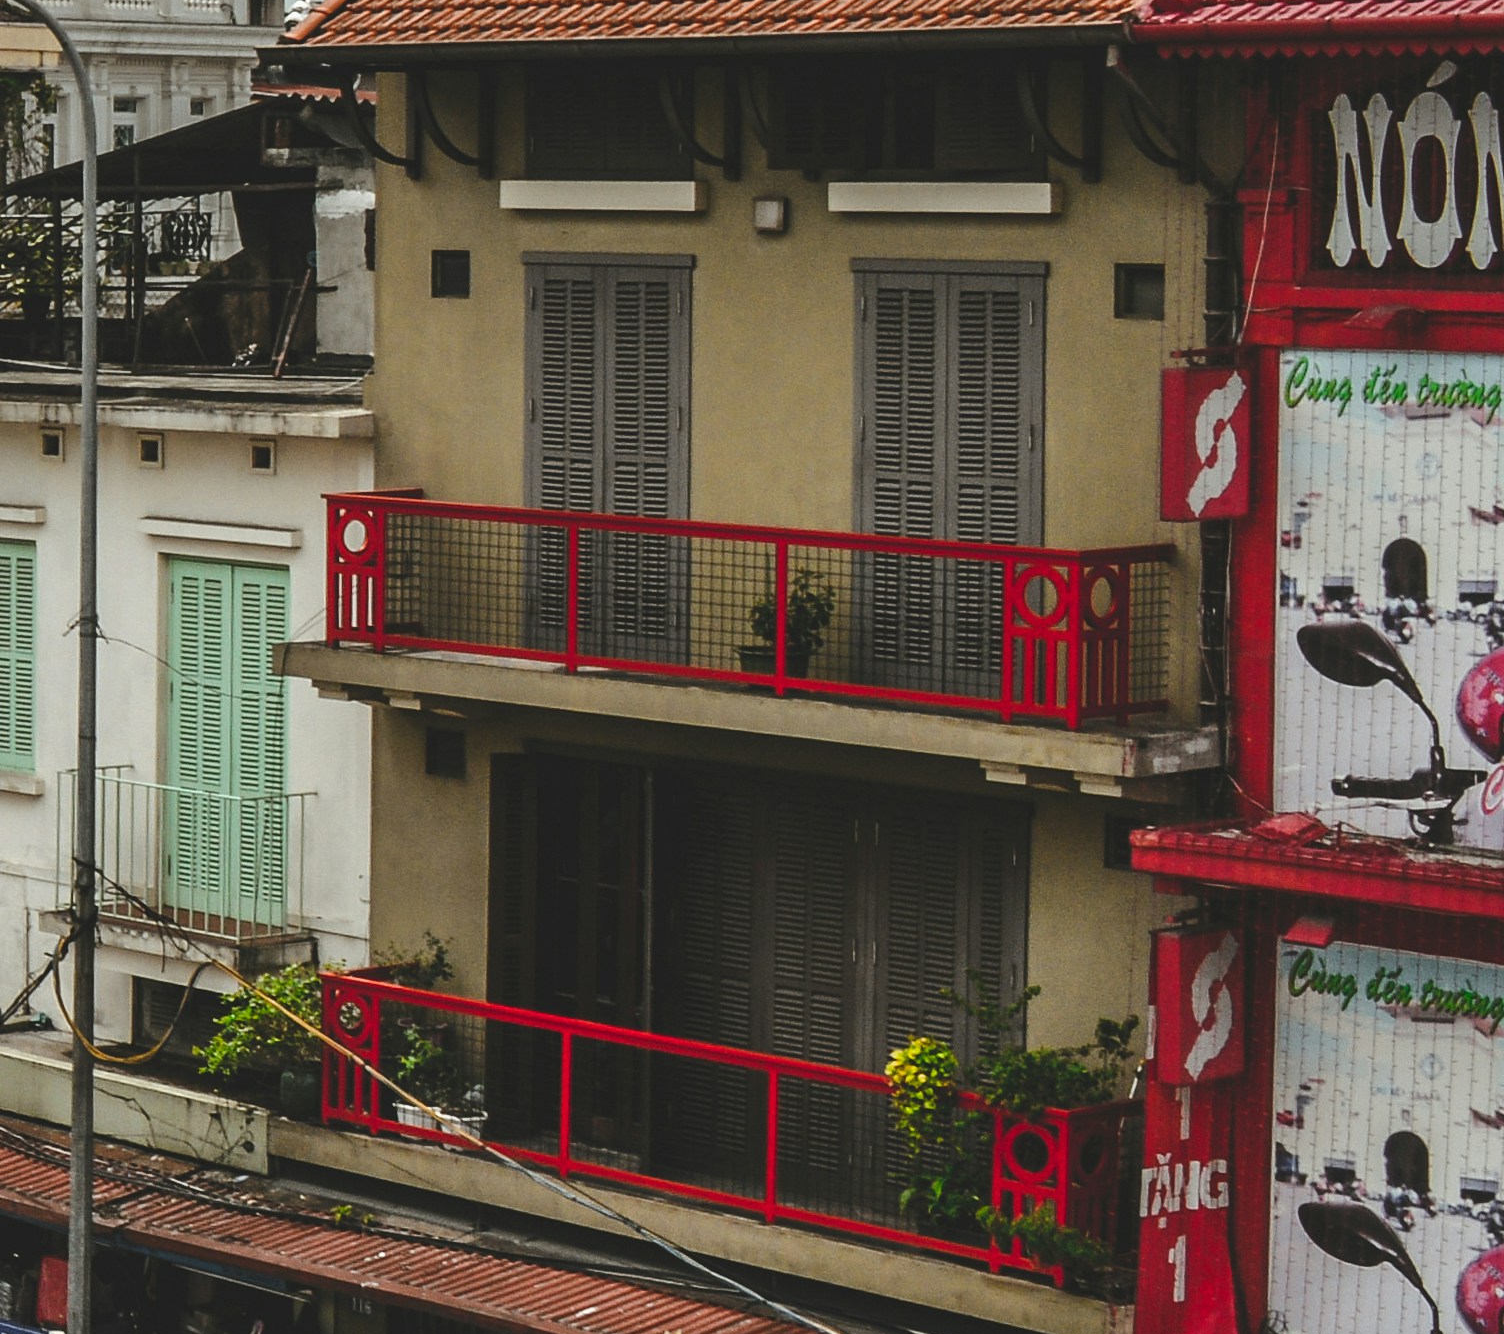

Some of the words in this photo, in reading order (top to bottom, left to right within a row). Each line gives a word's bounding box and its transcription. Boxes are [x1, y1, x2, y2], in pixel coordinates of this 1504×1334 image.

[1284, 356, 1353, 418] Cùng
[1363, 364, 1408, 406] đến
[1417, 368, 1502, 425] trường
[1288, 948, 1358, 1012] Cùng
[1366, 966, 1413, 1006] đến
